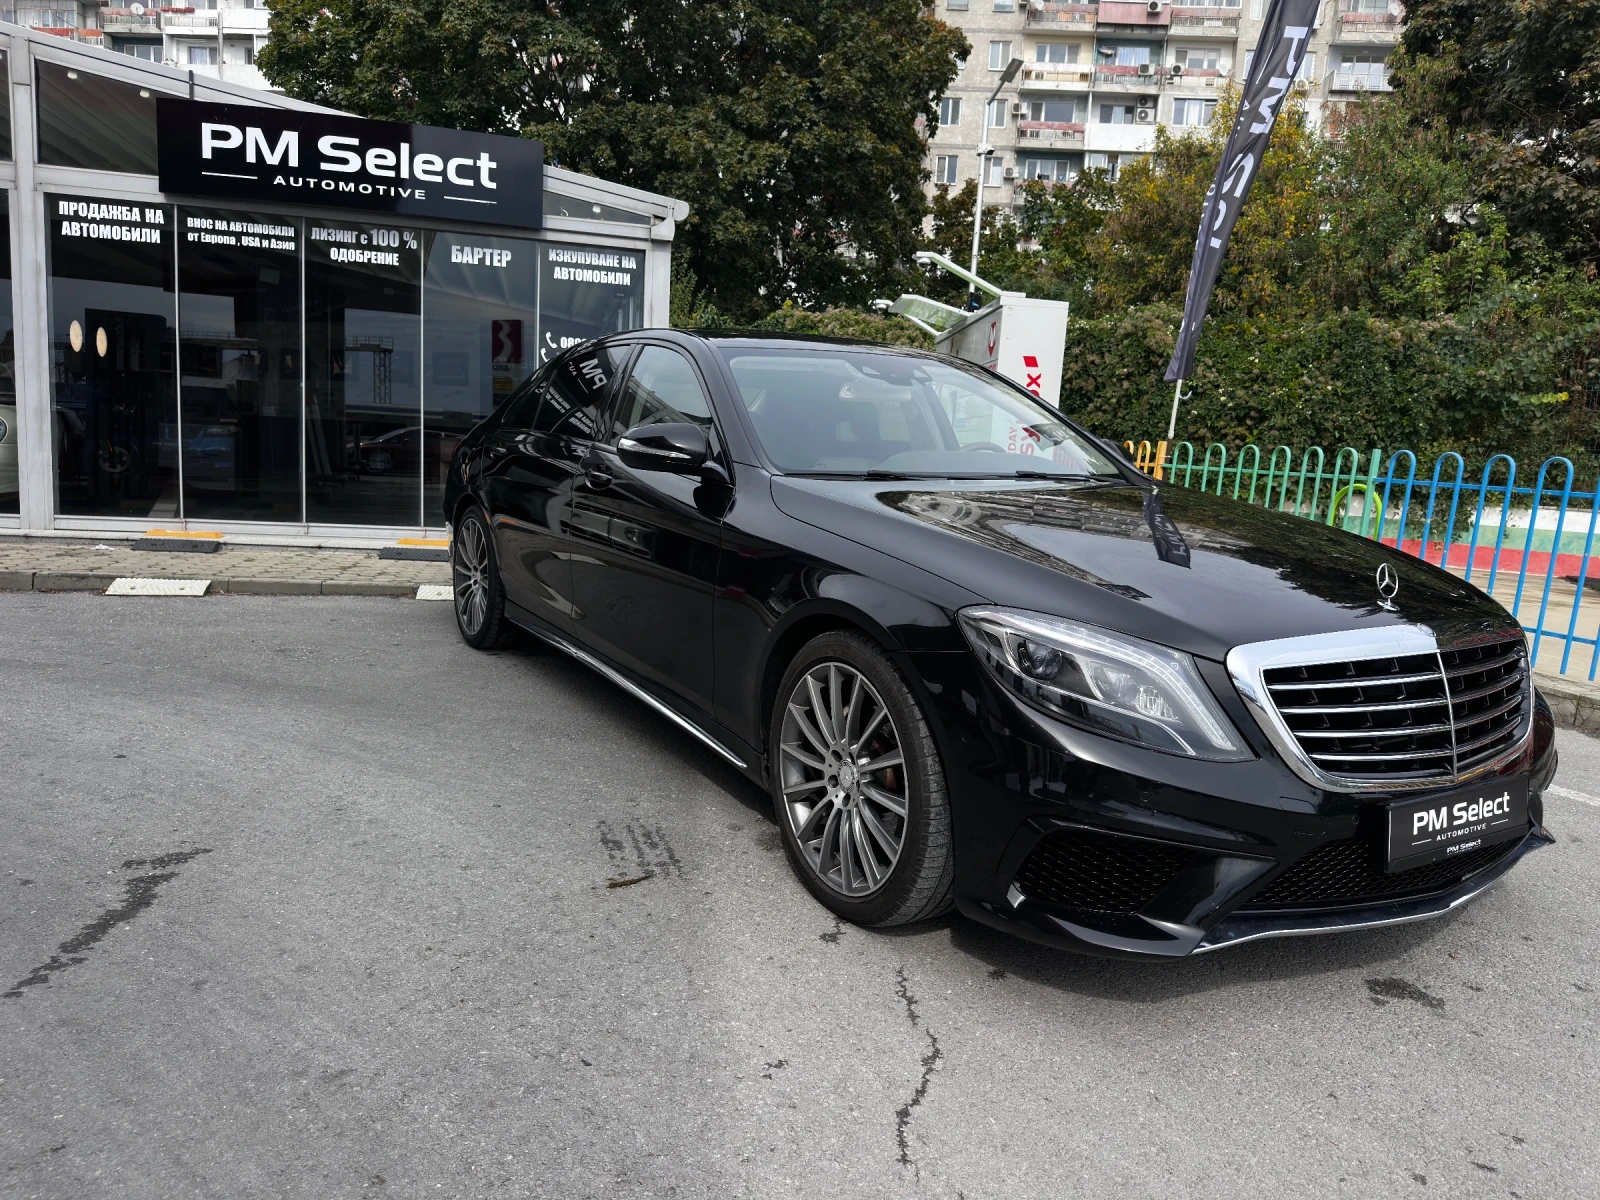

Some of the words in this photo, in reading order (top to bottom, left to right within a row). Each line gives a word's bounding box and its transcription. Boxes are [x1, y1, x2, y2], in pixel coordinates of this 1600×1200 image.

[201, 122, 299, 168] PM
[317, 135, 498, 189] Select
[273, 175, 426, 200] AUTOMOTIVE
[58, 201, 141, 223] ПРОДАЖБА
[145, 208, 165, 225] НА
[61, 221, 161, 244] АВТОМОБИЛИ
[187, 217, 214, 231] ВНОС
[214, 221, 229, 233] НА
[229, 222, 295, 238] АВТОМОБИЛИ
[311, 227, 359, 244] ЛИЗИНГ
[370, 228, 400, 248] 100
[187, 231, 200, 242] от
[200, 232, 236, 246] Европа
[241, 235, 261, 248] USA
[261, 240, 269, 249] и
[270, 238, 296, 251] Азия
[330, 247, 400, 266] ОДОБРЕНИЕ
[451, 245, 512, 268] БАРТЕР
[548, 248, 620, 268] ИЗКУПУВАНЕ
[621, 256, 637, 269] НА
[553, 266, 631, 286] АВТОМОБИЛИ
[1008, 426, 1018, 454] DAY
[1413, 806, 1448, 835] PM
[1452, 791, 1511, 826] Select
[1436, 822, 1487, 841] AUTOMOTIVE
[1446, 844, 1460, 854] PM
[1460, 839, 1482, 851] Select
